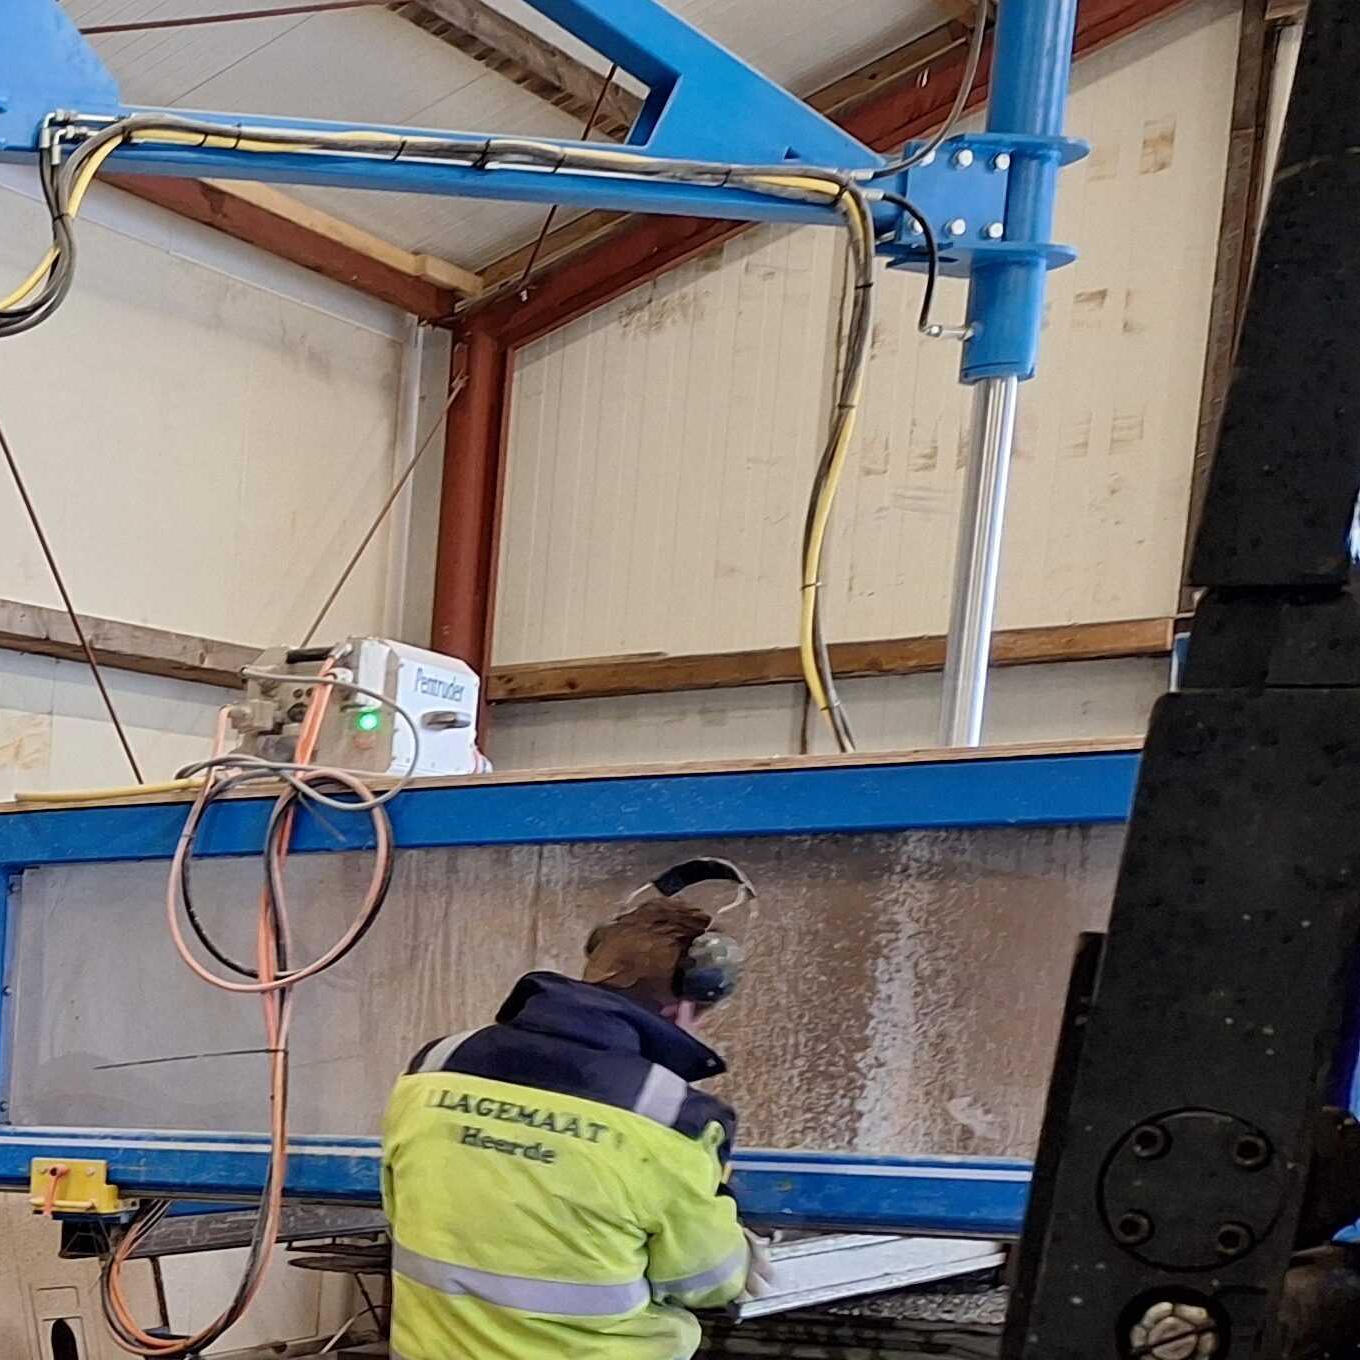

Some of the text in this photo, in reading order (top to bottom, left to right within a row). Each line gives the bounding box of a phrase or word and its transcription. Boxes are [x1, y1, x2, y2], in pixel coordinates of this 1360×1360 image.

[414, 667, 465, 703] Pentruder
[435, 1089, 609, 1144] LAGEMAAT
[459, 1125, 556, 1165] Heerde
